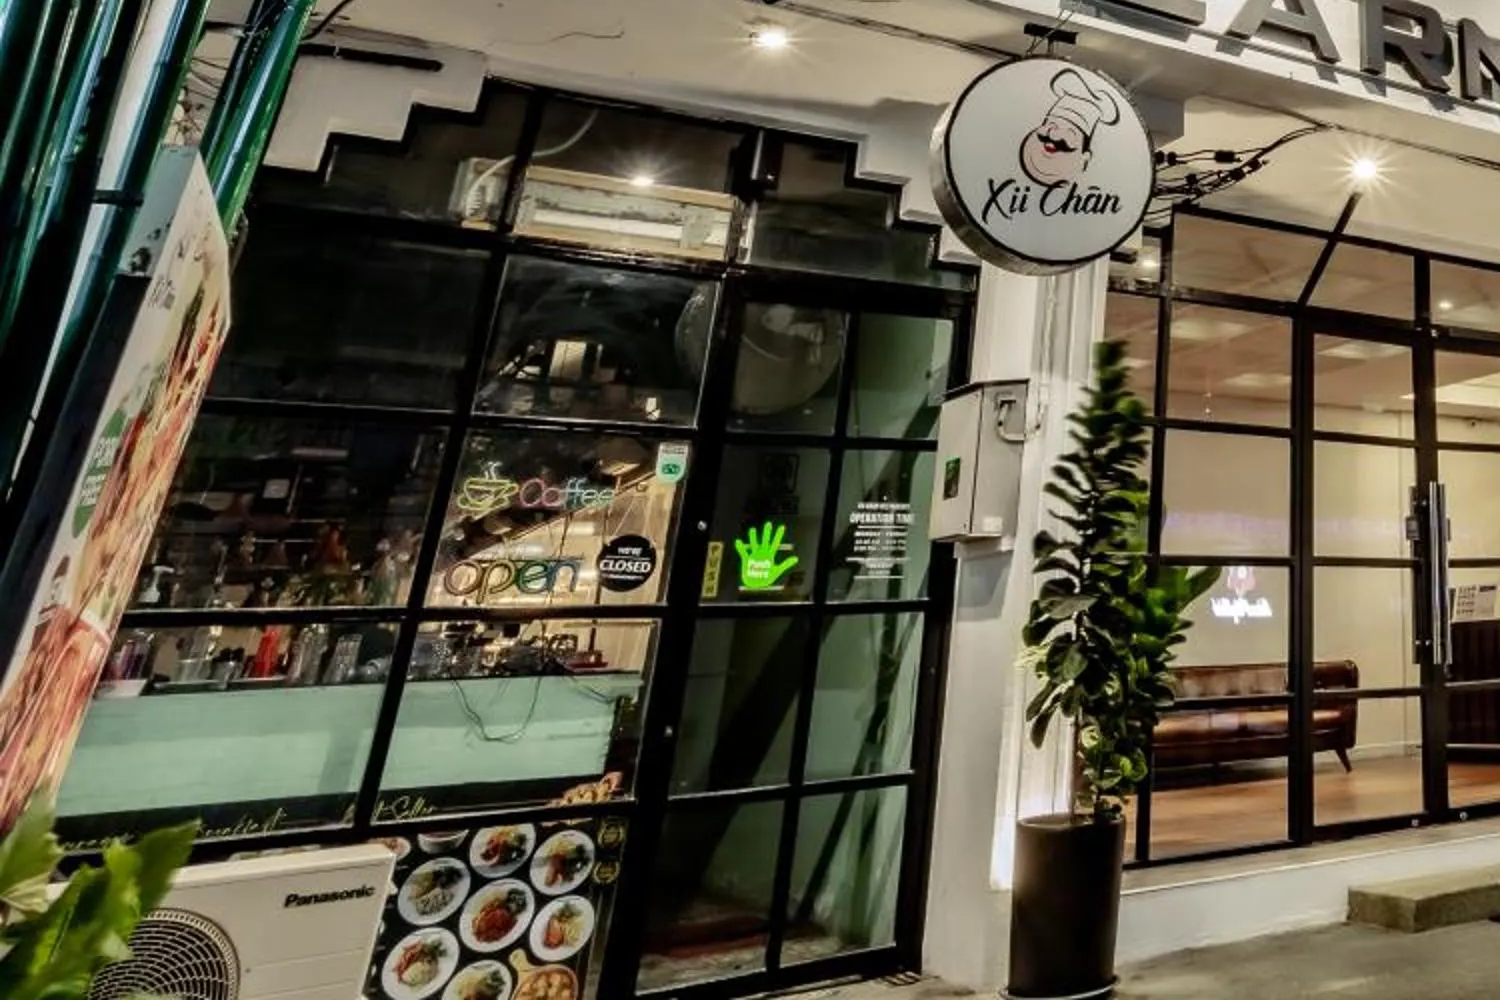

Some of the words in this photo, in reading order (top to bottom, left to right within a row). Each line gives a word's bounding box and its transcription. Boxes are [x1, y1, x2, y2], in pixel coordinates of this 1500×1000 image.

[600, 558, 651, 574] CLOSED
[444, 558, 583, 605] open
[283, 884, 377, 908] Panasonic
